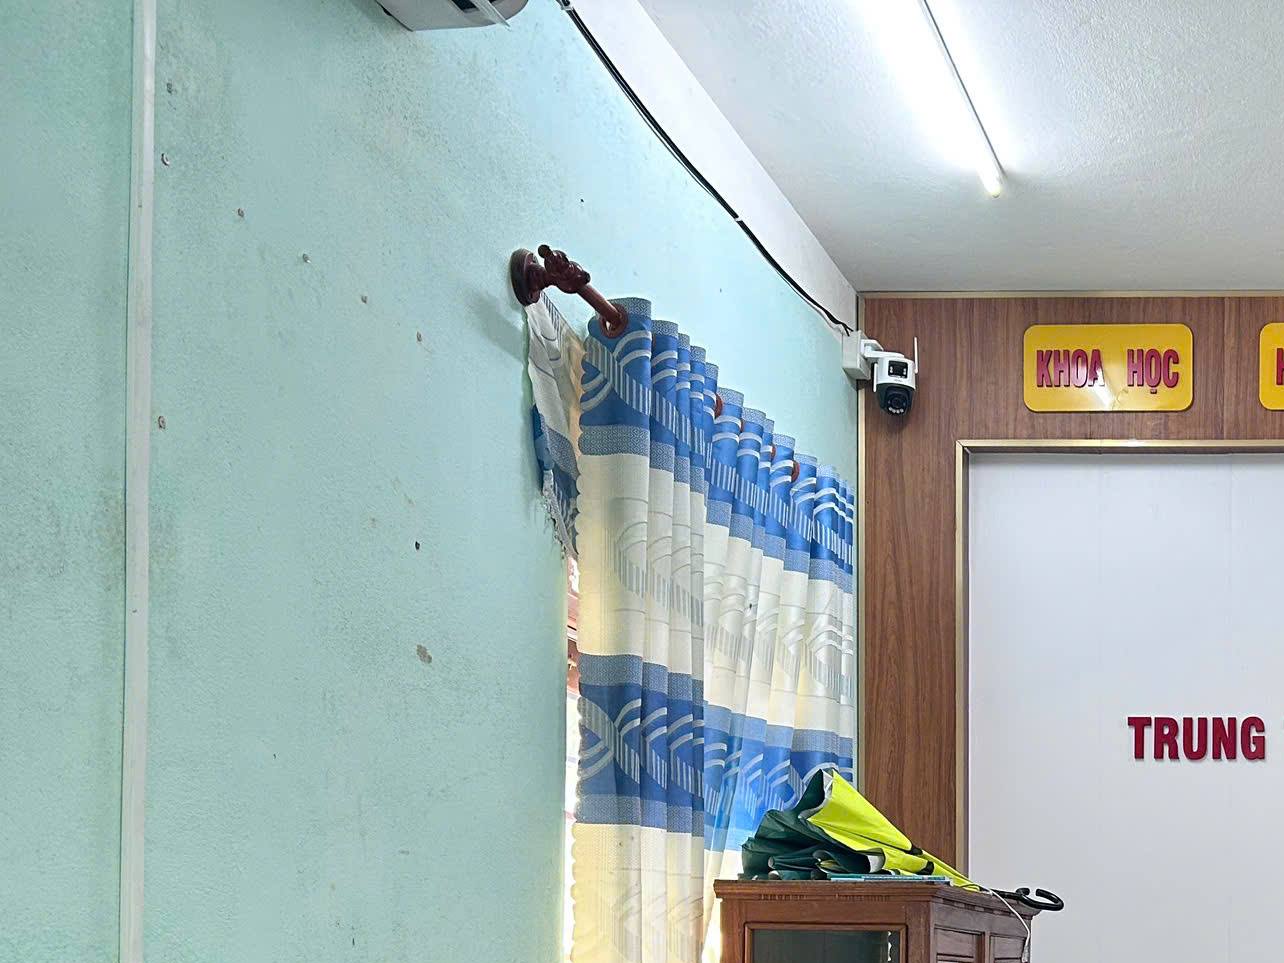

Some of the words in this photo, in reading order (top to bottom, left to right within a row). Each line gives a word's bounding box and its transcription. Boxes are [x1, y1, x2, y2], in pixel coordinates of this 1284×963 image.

[1037, 349, 1105, 388] KHOA
[1127, 349, 1179, 393] HỌC
[1128, 716, 1265, 761] TRUNG
